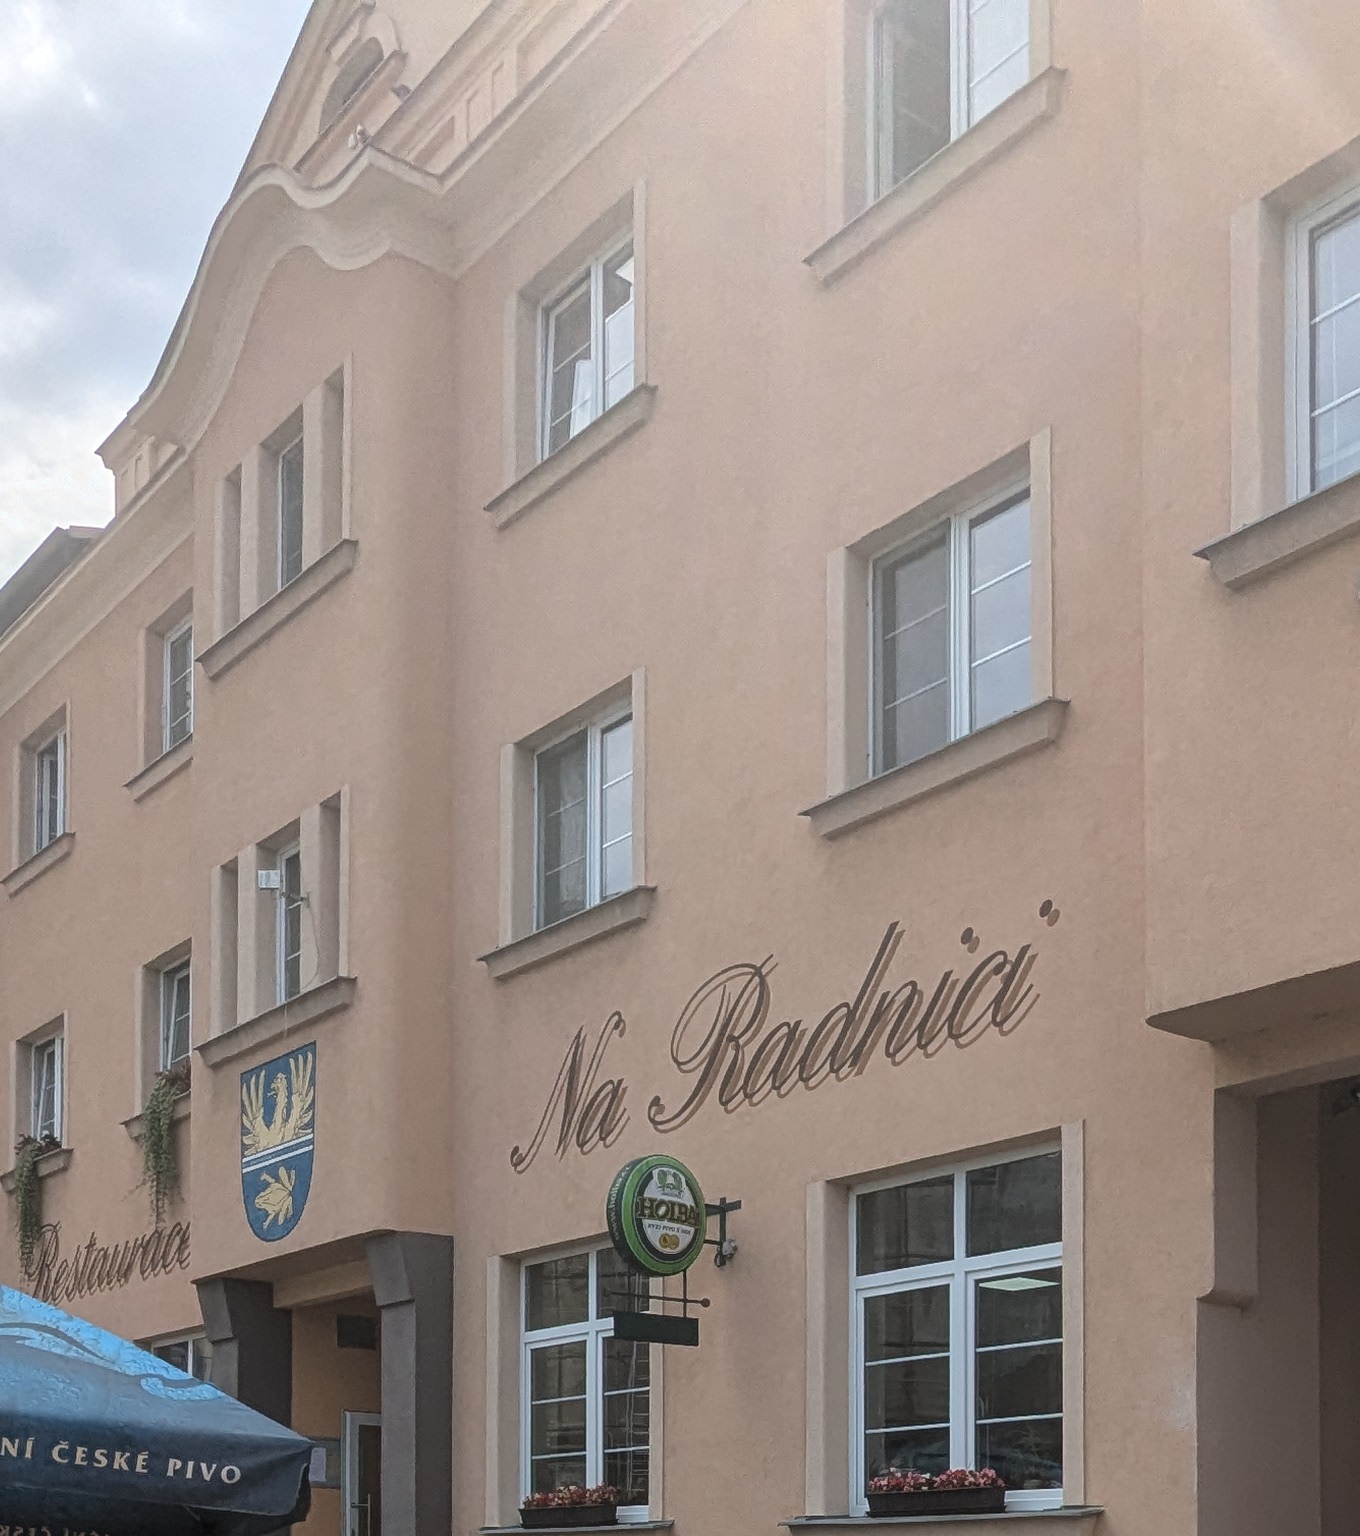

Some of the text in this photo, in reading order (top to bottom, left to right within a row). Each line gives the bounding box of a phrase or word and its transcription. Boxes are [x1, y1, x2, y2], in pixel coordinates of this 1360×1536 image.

[511, 1011, 630, 1175] Na
[636, 1195, 700, 1229] HOLBA
[51, 1440, 151, 1474] ČESKÉ
[166, 1457, 242, 1485] PIVO
